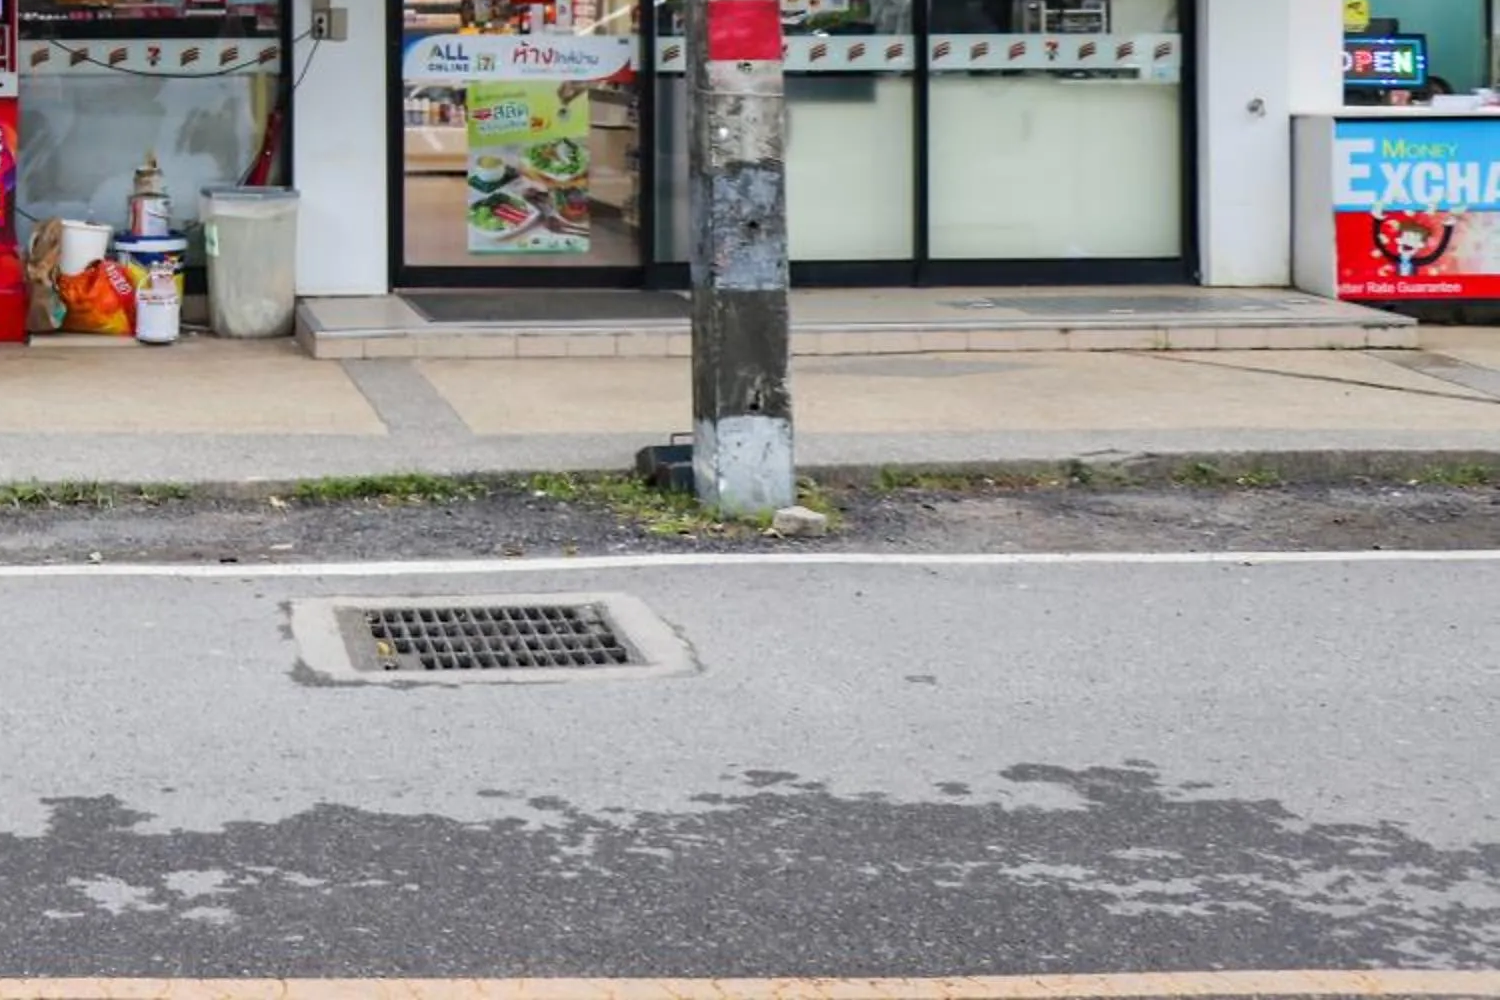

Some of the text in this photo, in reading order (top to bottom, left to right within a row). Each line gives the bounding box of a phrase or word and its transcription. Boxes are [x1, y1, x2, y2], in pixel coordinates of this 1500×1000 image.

[427, 43, 469, 62] ALL
[1381, 138, 1458, 158] MONEY
[1397, 281, 1462, 294] Guarantee
